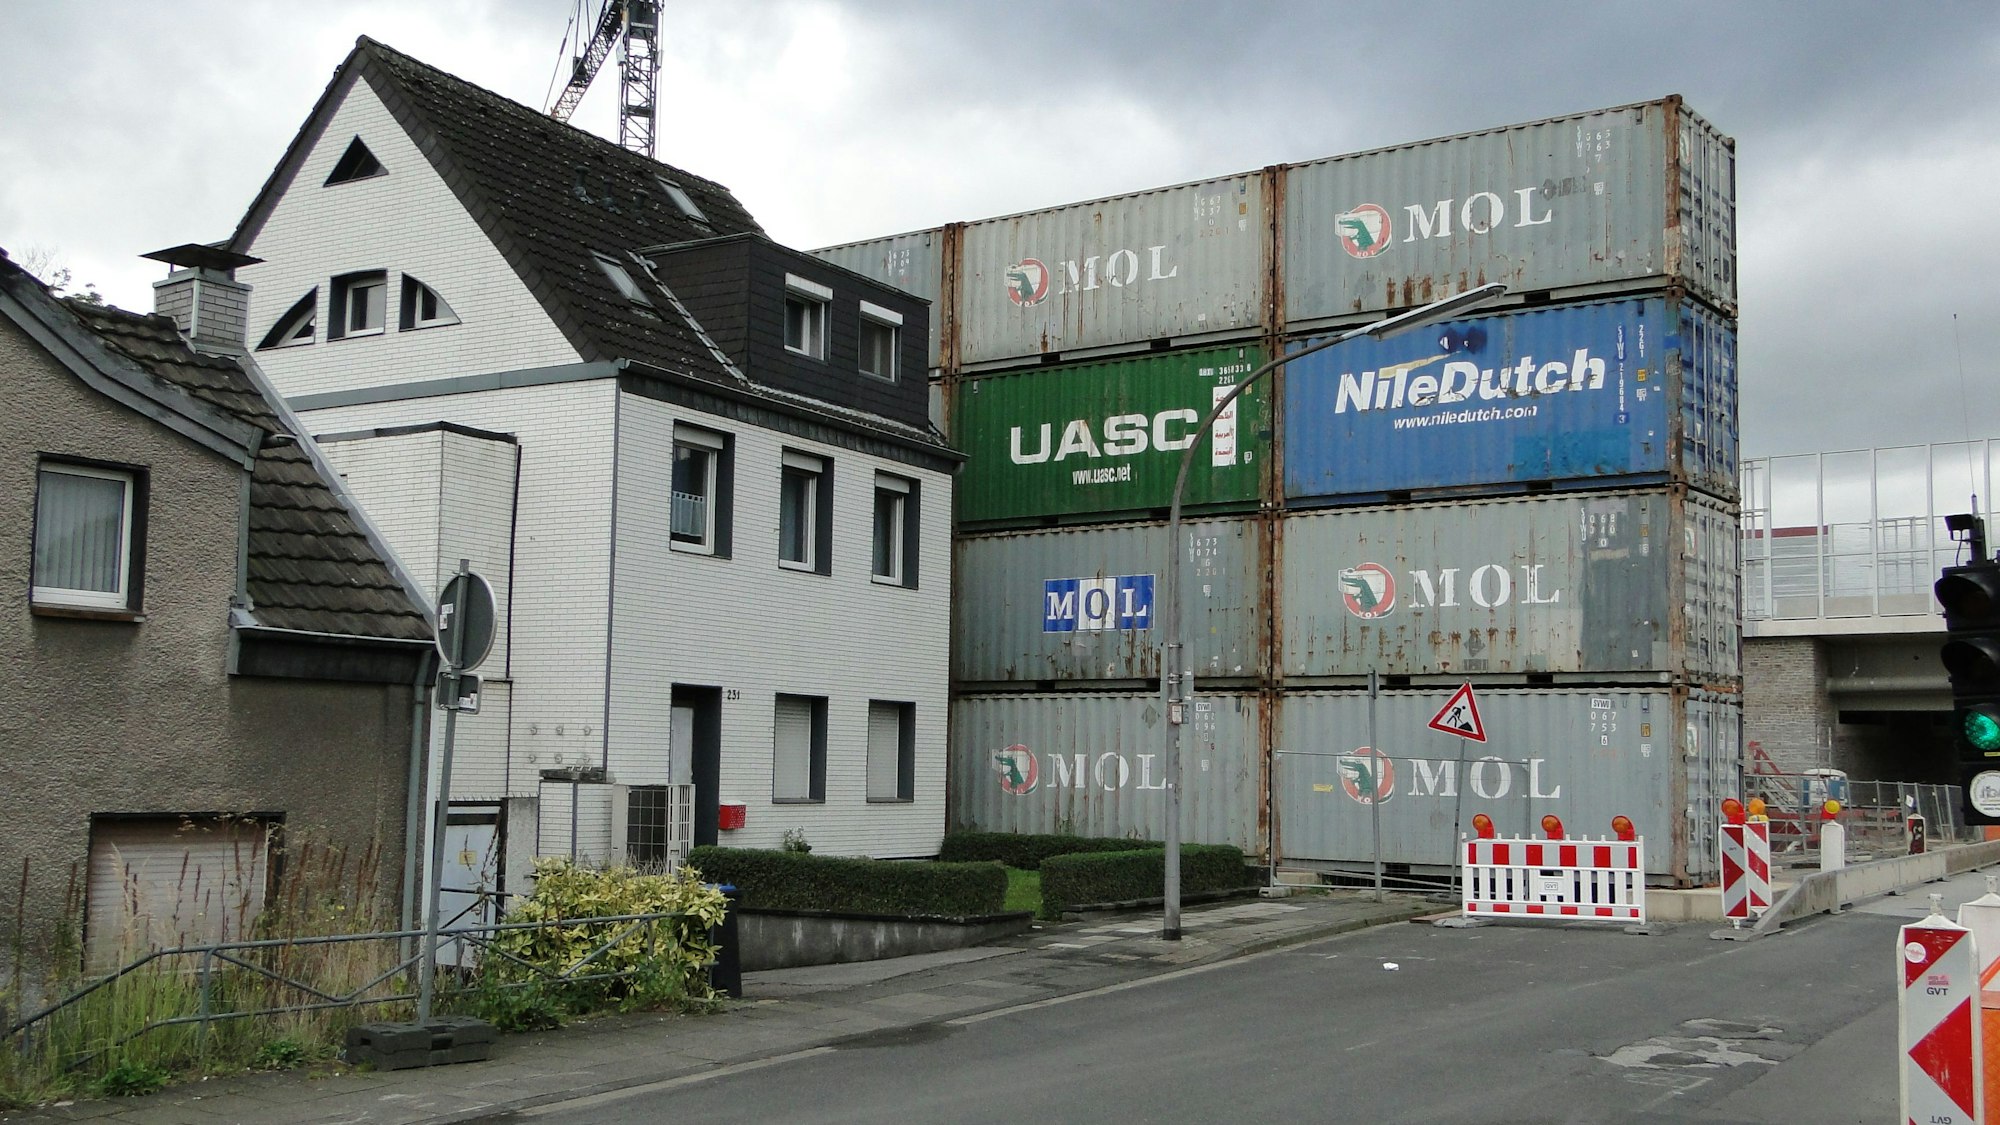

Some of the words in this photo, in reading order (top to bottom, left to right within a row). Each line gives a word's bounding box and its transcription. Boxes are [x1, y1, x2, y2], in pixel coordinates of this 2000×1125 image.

[1403, 187, 1552, 243] MOL
[1059, 245, 1177, 295] MOL
[1334, 349, 1607, 414] NileDutch
[1393, 404, 1537, 430] www.niledutch.com
[1010, 409, 1198, 464] UASC
[1072, 463, 1131, 485] www.uasc.net
[1589, 513, 1616, 523] 068
[1196, 537, 1217, 547] 673
[1196, 548, 1217, 556] 074
[1408, 564, 1560, 608] MOL
[1047, 588, 1147, 620] MOL
[727, 689, 740, 700] 231
[1591, 711, 1617, 720] 067
[1195, 722, 1216, 730] 096
[1591, 722, 1617, 732] 753
[1602, 735, 1608, 745] 6
[1046, 752, 1167, 791] MOL
[1407, 758, 1561, 799] MOL
[1926, 987, 1949, 996] GVT
[1930, 1115, 1952, 1125] GVT
